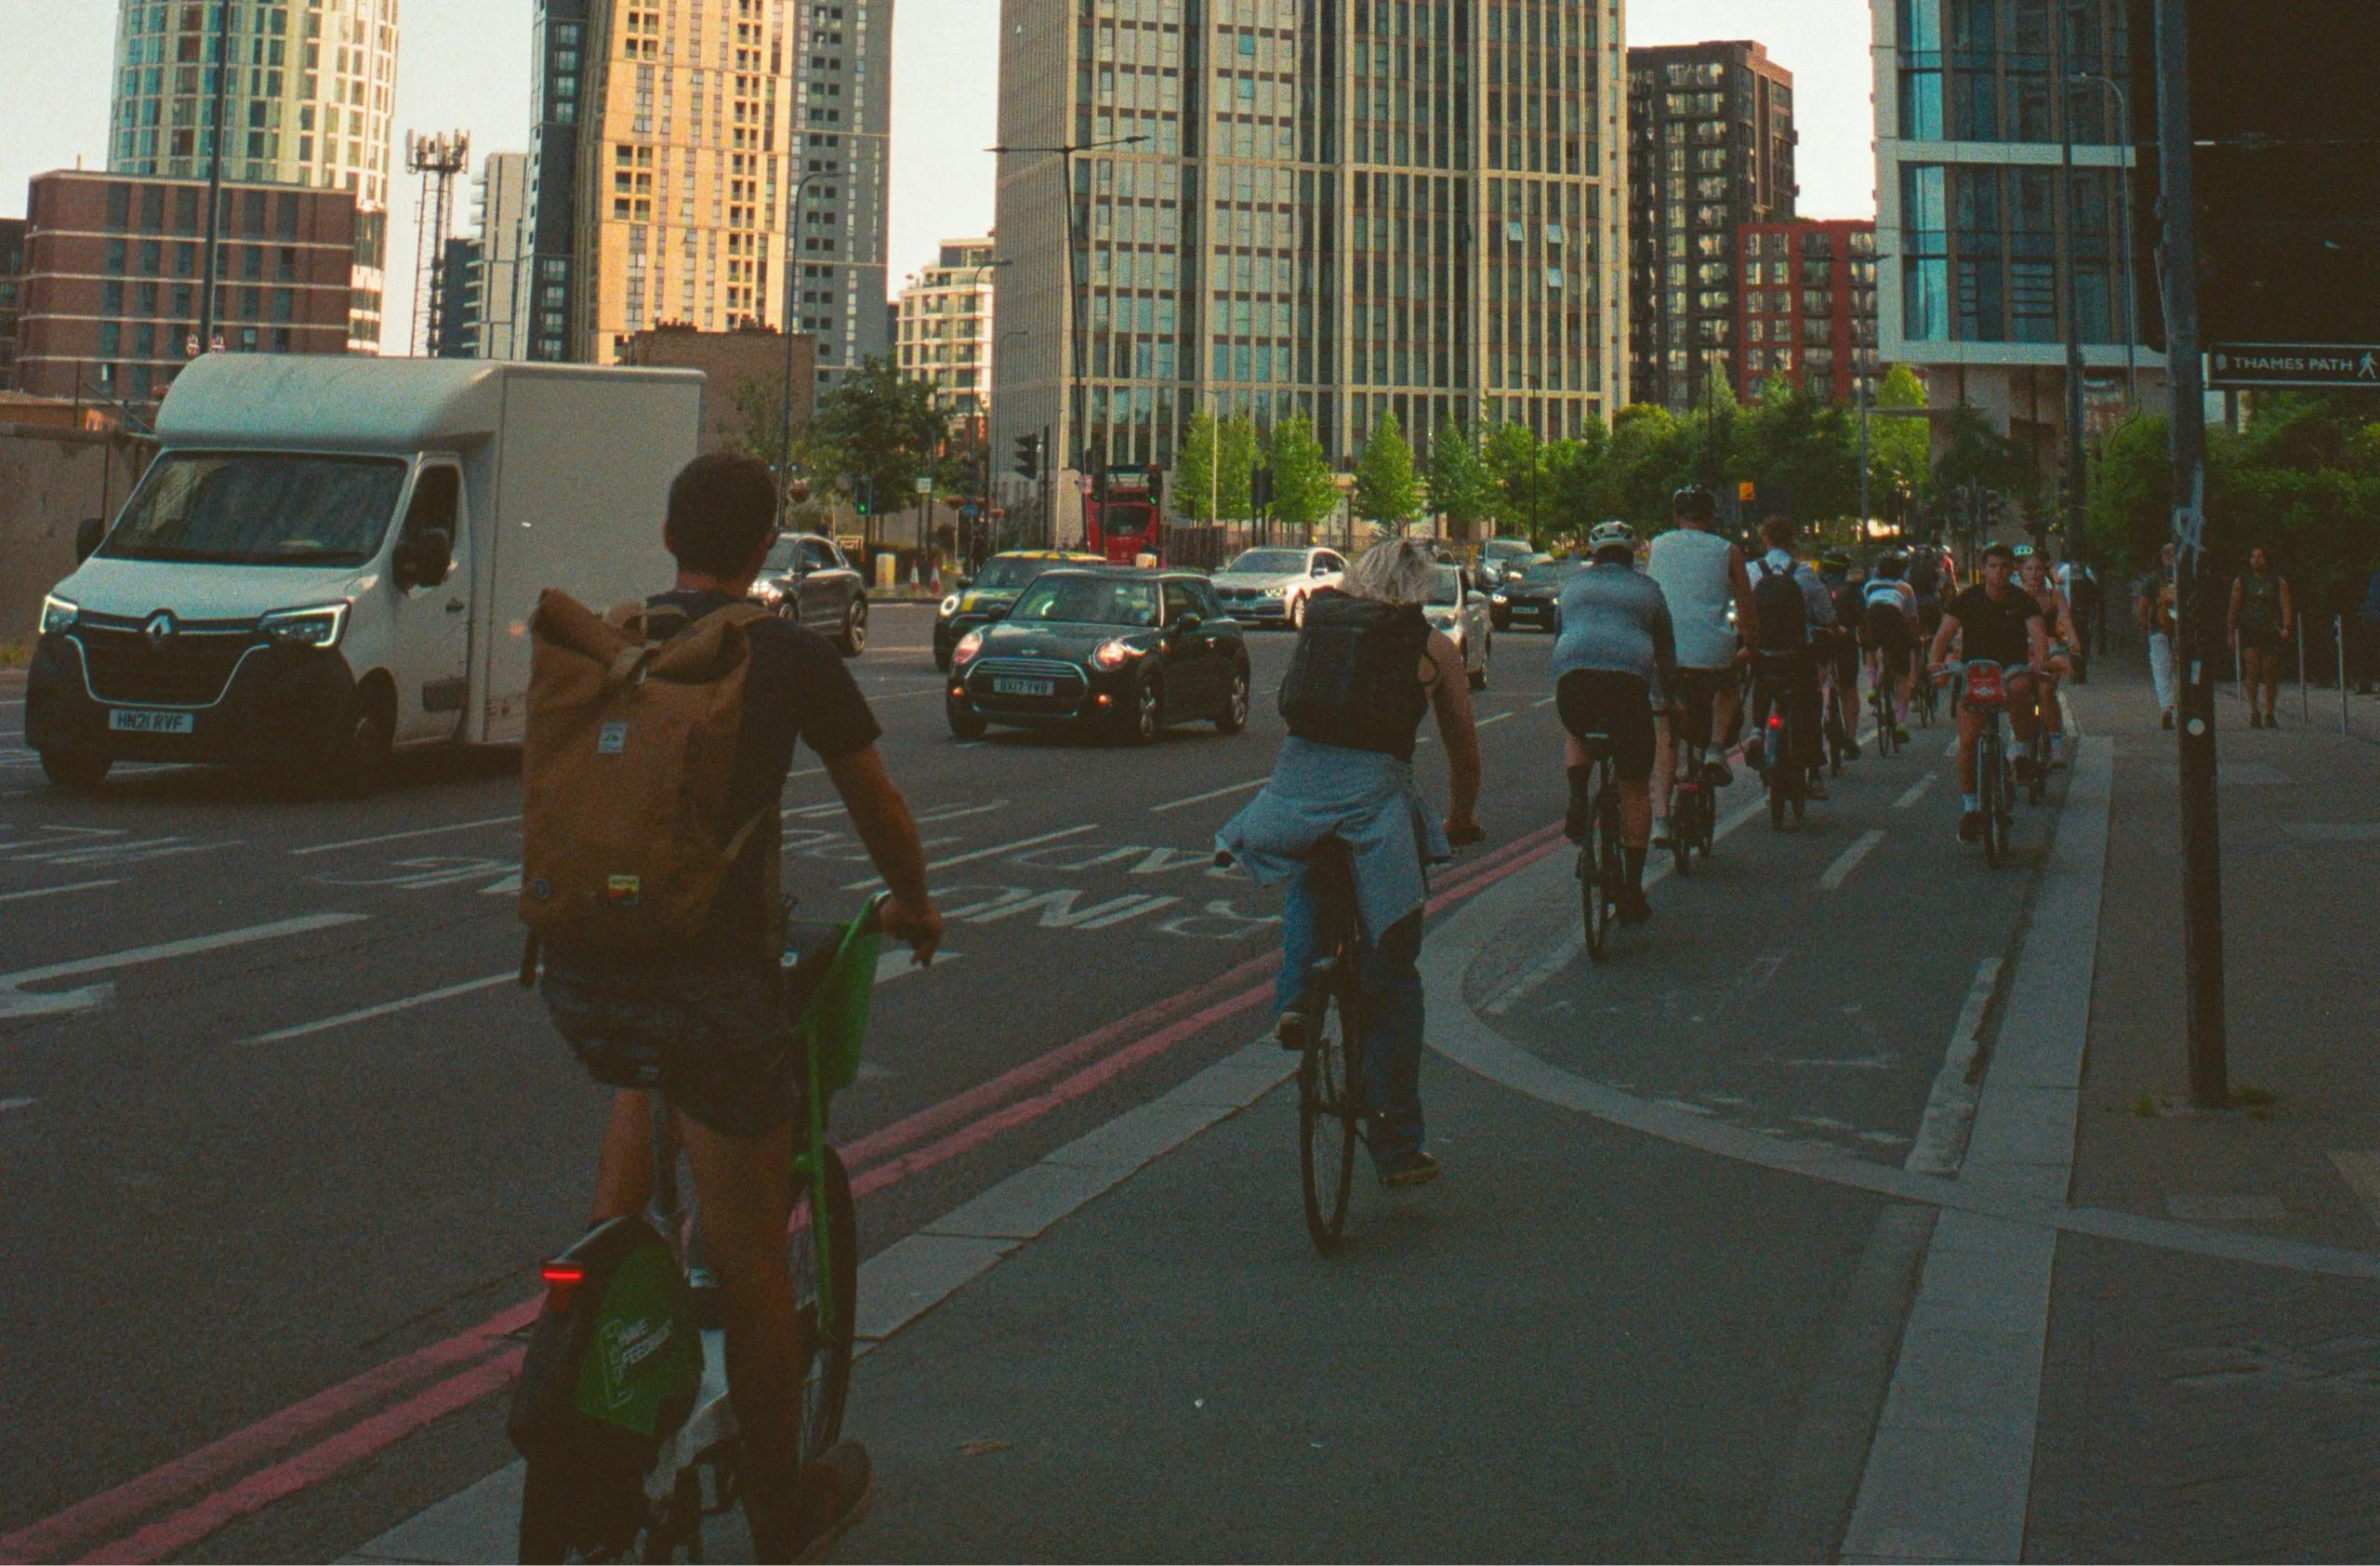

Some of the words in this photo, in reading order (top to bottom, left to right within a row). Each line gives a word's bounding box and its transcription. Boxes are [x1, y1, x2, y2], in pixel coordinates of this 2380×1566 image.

[2232, 357, 2304, 371] THAMES
[2309, 359, 2353, 372] PATH
[117, 711, 151, 729] HN21
[153, 713, 183, 730] RVF
